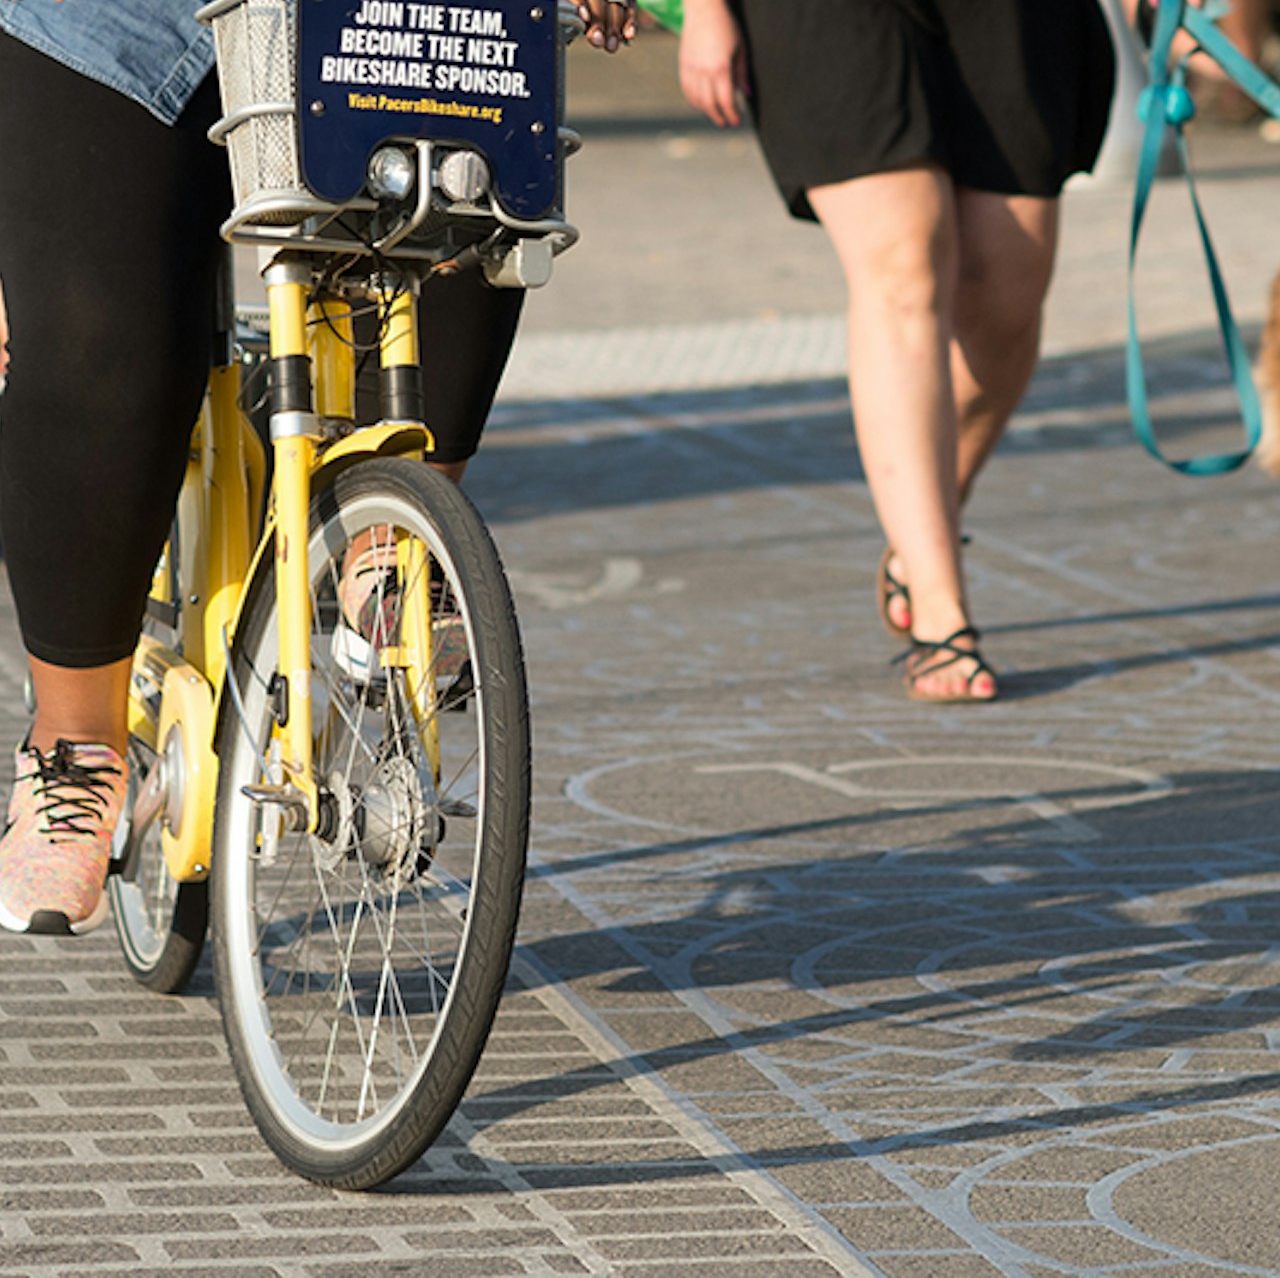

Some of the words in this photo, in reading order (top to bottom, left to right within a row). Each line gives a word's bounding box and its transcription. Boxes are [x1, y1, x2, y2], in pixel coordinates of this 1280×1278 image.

[406, 3, 445, 31] THE
[448, 6, 508, 39] TEAM,
[340, 27, 424, 59] BECOME
[427, 33, 464, 62] THE
[466, 38, 519, 67] NEXT
[321, 55, 433, 89] BIKESHARE
[434, 63, 531, 98] SPONSOR.
[348, 92, 377, 110] Visit
[378, 93, 503, 124] PacersBikeshare.org
